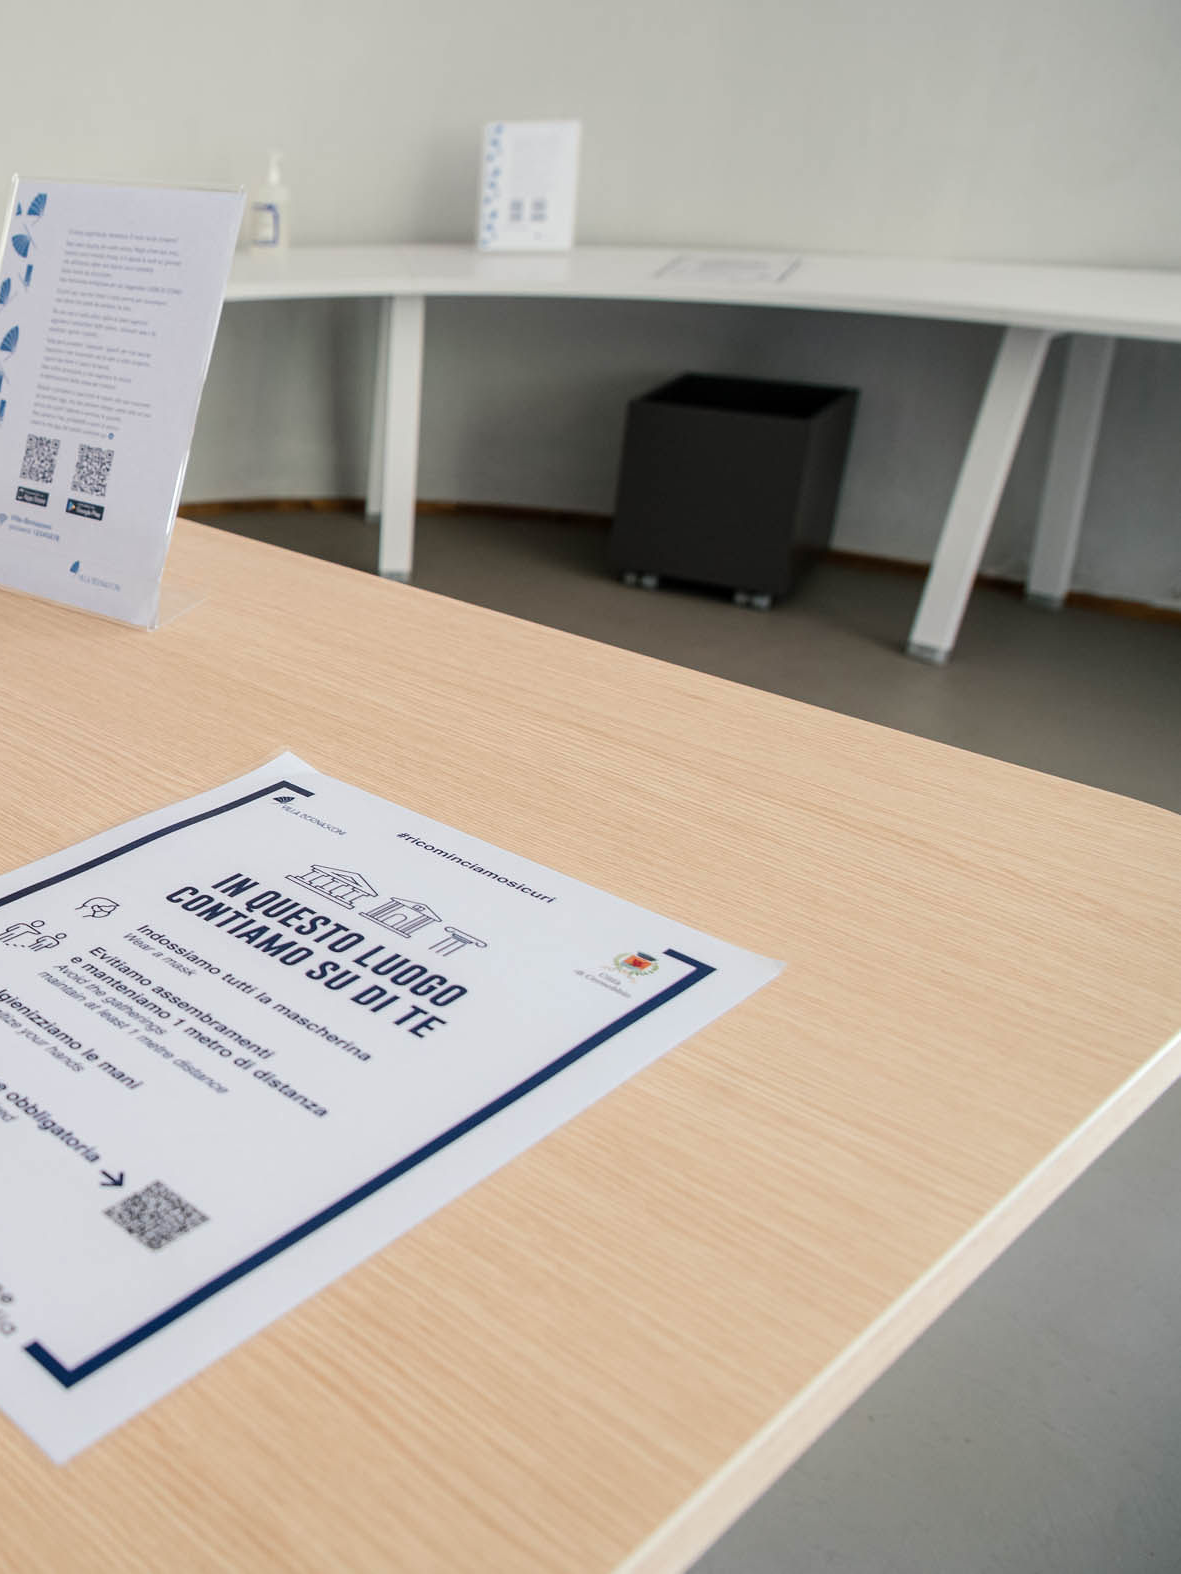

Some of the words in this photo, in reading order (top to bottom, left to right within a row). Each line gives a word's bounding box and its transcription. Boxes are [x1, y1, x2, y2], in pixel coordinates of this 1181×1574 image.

[396, 831, 559, 904] #ricominciamosicuri
[122, 931, 153, 955] Wear
[151, 950, 162, 960] a
[160, 955, 198, 978] mask
[165, 886, 315, 966] CONTIAMO
[305, 960, 362, 992] SU
[350, 984, 401, 1013] DI
[392, 1004, 448, 1040] TE
[210, 872, 260, 899] IN
[244, 889, 366, 954] QUESTO
[352, 945, 469, 1008] LUOGO
[37, 969, 87, 1004] maintain
[83, 995, 101, 1009] at
[95, 1006, 129, 1031] least
[125, 1027, 139, 1037] 1
[135, 1034, 175, 1060] metre
[172, 1057, 230, 1095] distance
[53, 963, 89, 990] Avoid
[85, 982, 106, 998] the
[100, 994, 168, 1037] gatherings
[69, 955, 83, 965] e
[77, 959, 171, 1020] manteniamo
[172, 1017, 185, 1028] 1
[183, 1026, 233, 1059] metro
[233, 1055, 256, 1071] di
[252, 1068, 329, 1119] distanza
[88, 945, 153, 988] Evitiamo
[151, 984, 276, 1061] assembramenti
[136, 924, 222, 976] Indossiamo
[221, 972, 257, 996] tutti
[254, 990, 273, 1005] la
[271, 1002, 372, 1063] mascherina
[17, 1025, 50, 1047] your
[45, 1045, 86, 1074] hands
[80, 1047, 100, 1062] le
[98, 1060, 144, 1090] mani
[5, 1091, 102, 1164] obbligatoria
